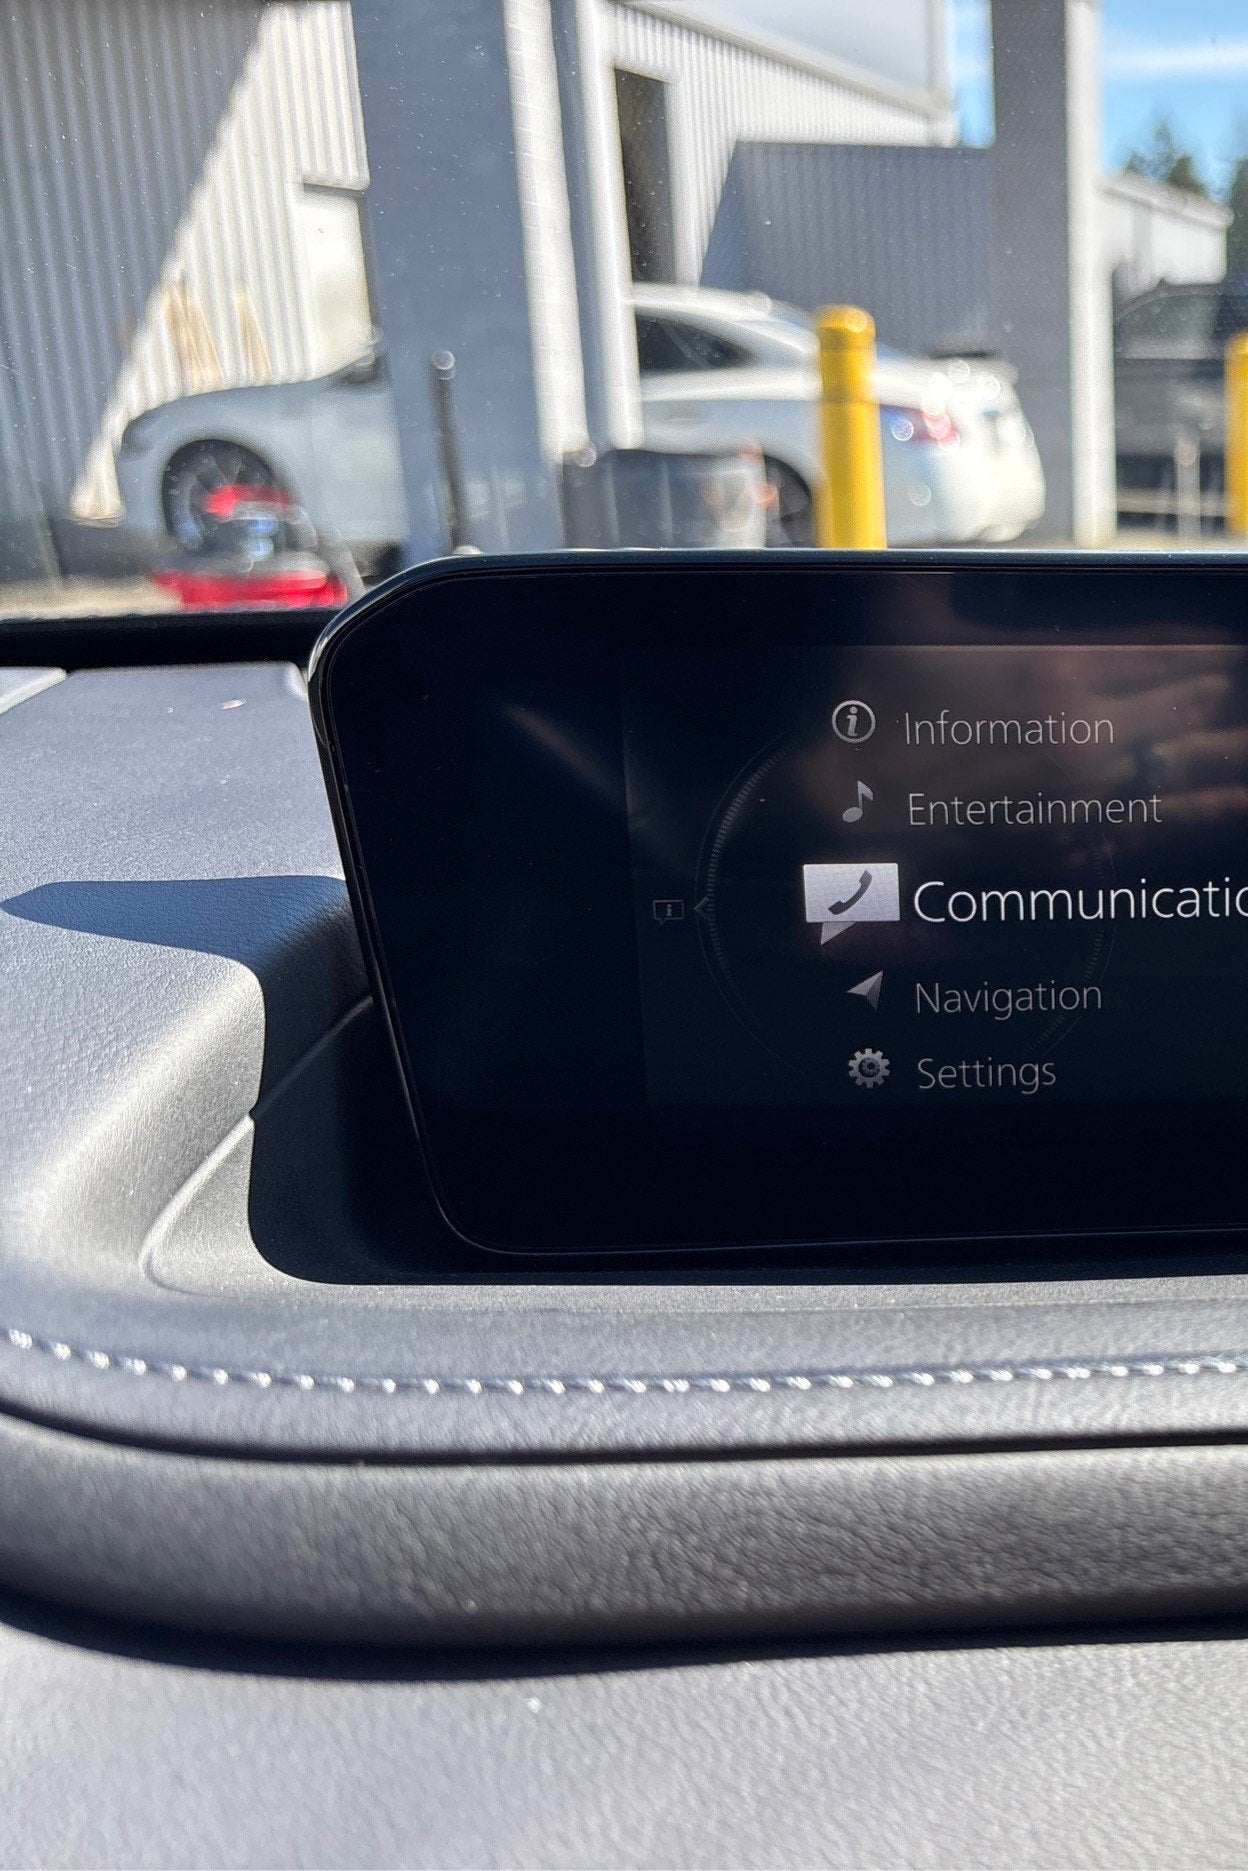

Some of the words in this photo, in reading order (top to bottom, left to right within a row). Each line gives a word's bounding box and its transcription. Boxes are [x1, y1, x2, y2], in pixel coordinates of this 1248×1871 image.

[904, 710, 1115, 746] Information
[908, 792, 1163, 826] Entertainment
[915, 980, 1102, 1020] Navigation
[917, 1057, 1057, 1095] Settings
